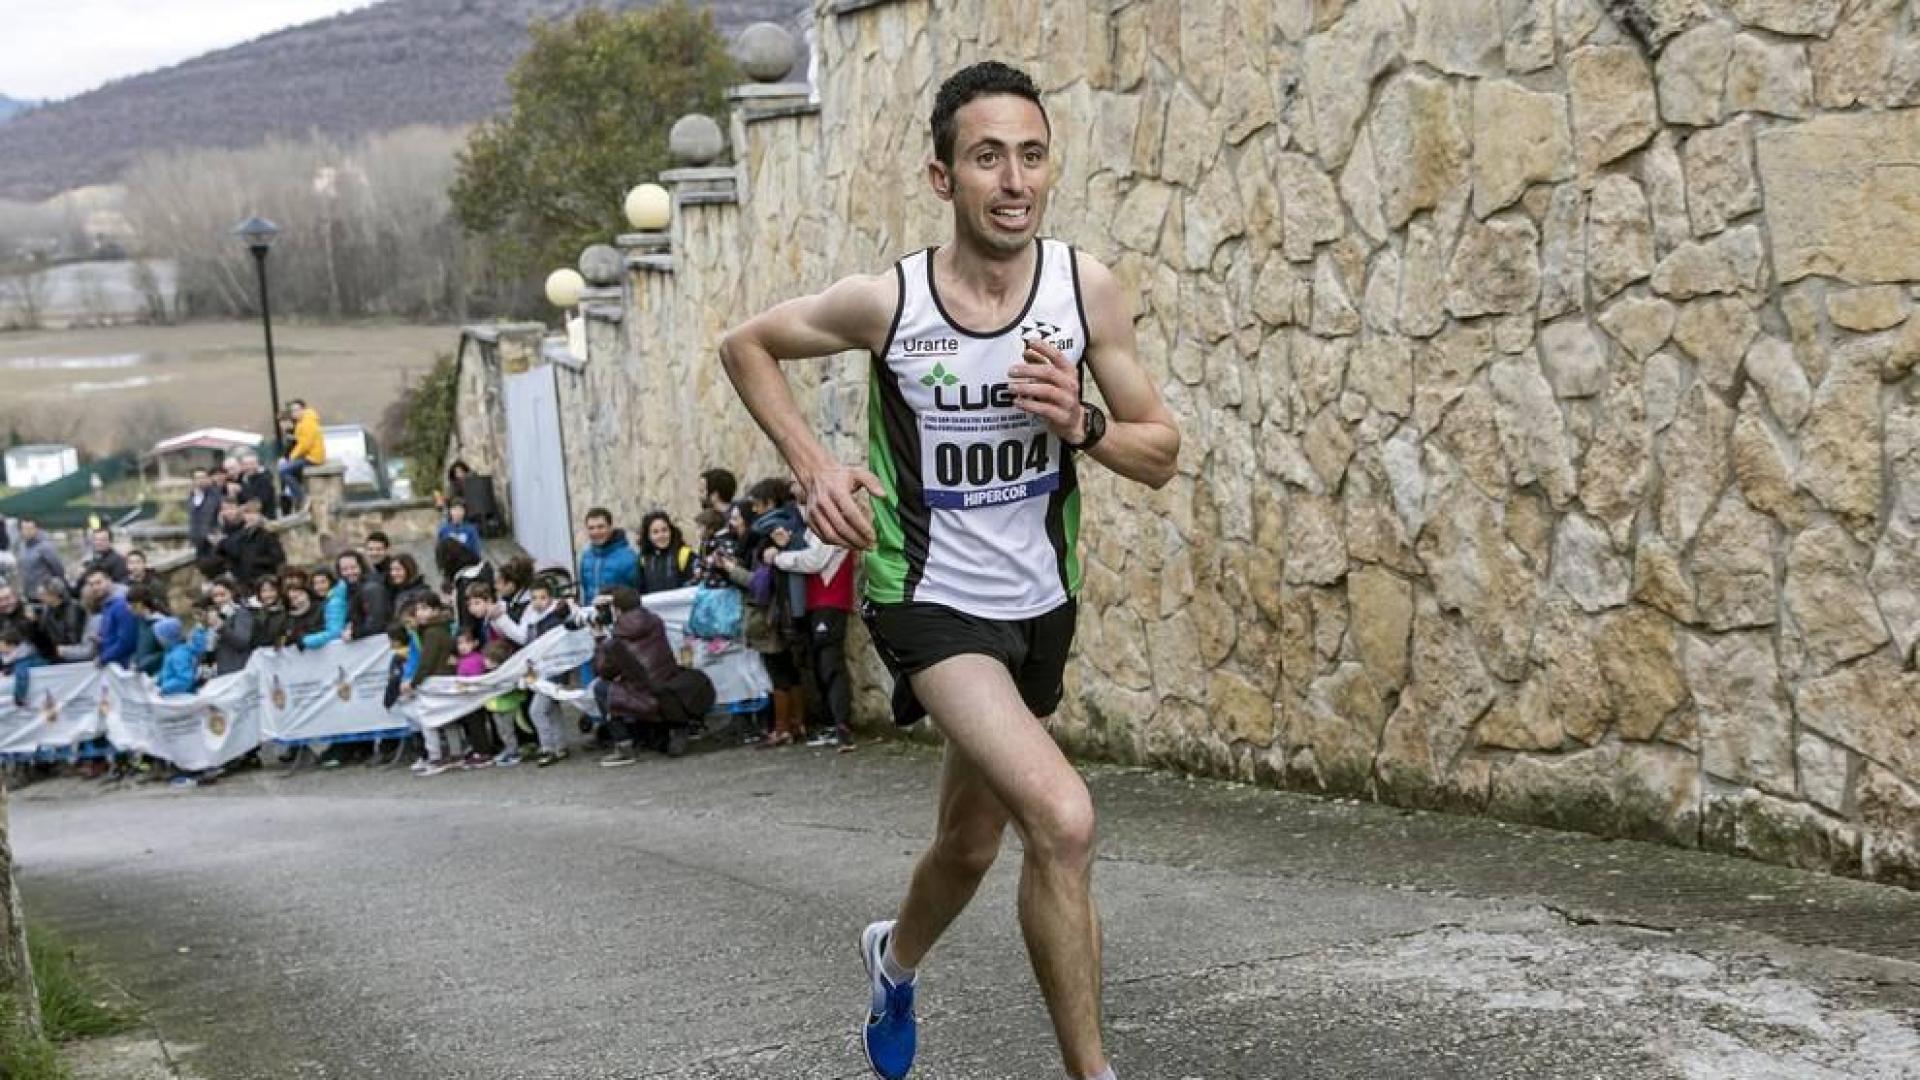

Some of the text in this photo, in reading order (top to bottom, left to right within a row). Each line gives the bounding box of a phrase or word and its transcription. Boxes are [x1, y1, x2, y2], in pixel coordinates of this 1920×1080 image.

[903, 337, 959, 352] Urarte
[934, 382, 1017, 411] LUG
[935, 431, 1050, 487] 0004
[963, 484, 1027, 507] HIPERCOR
